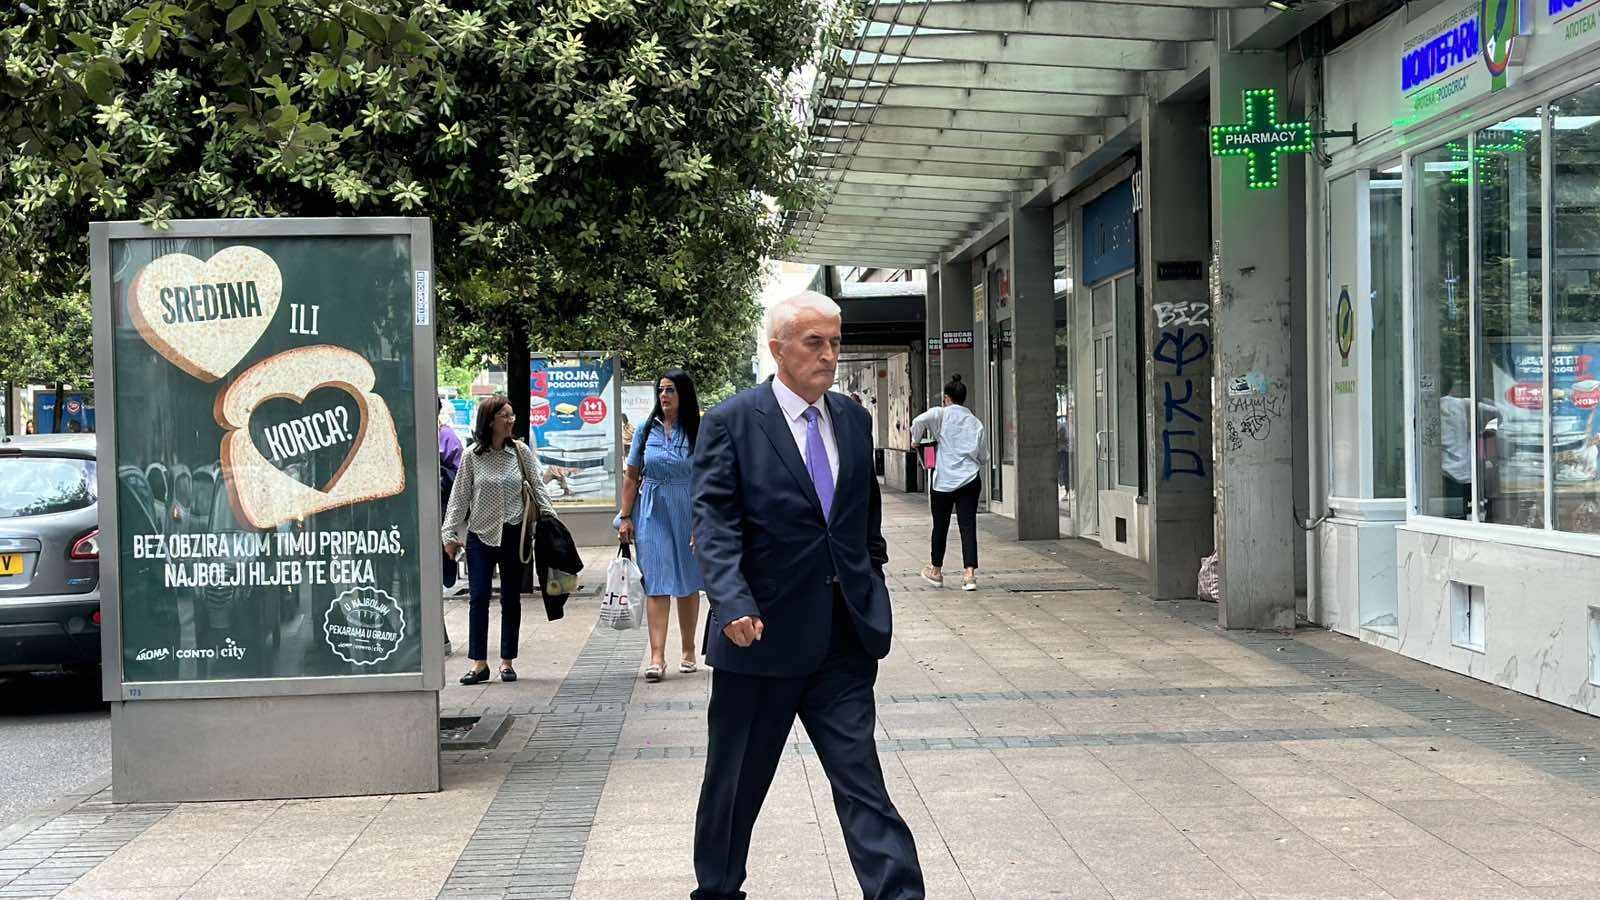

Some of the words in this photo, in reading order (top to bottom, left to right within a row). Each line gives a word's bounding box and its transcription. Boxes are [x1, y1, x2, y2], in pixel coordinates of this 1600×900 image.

[1225, 130, 1297, 145] PHARMACY
[159, 280, 263, 325] SREDINA
[289, 303, 320, 335] ILI
[547, 370, 600, 380] TROJNA
[547, 381, 600, 389] POGODNOST
[584, 400, 603, 411] 1+1
[264, 405, 354, 461] KORICA?
[134, 535, 166, 559] BEZ
[169, 533, 230, 558] OBZIRA
[233, 533, 271, 557] KOM
[274, 531, 317, 556] TIMU
[319, 525, 405, 557] PRIPADAŠ,
[164, 561, 247, 587] NAJBOLJI
[249, 560, 303, 586] HLJEB
[308, 560, 327, 585] TE
[329, 558, 375, 584] ČEKA
[329, 624, 366, 638] PEKARAMA
[366, 630, 372, 638] U
[221, 638, 247, 660] city
